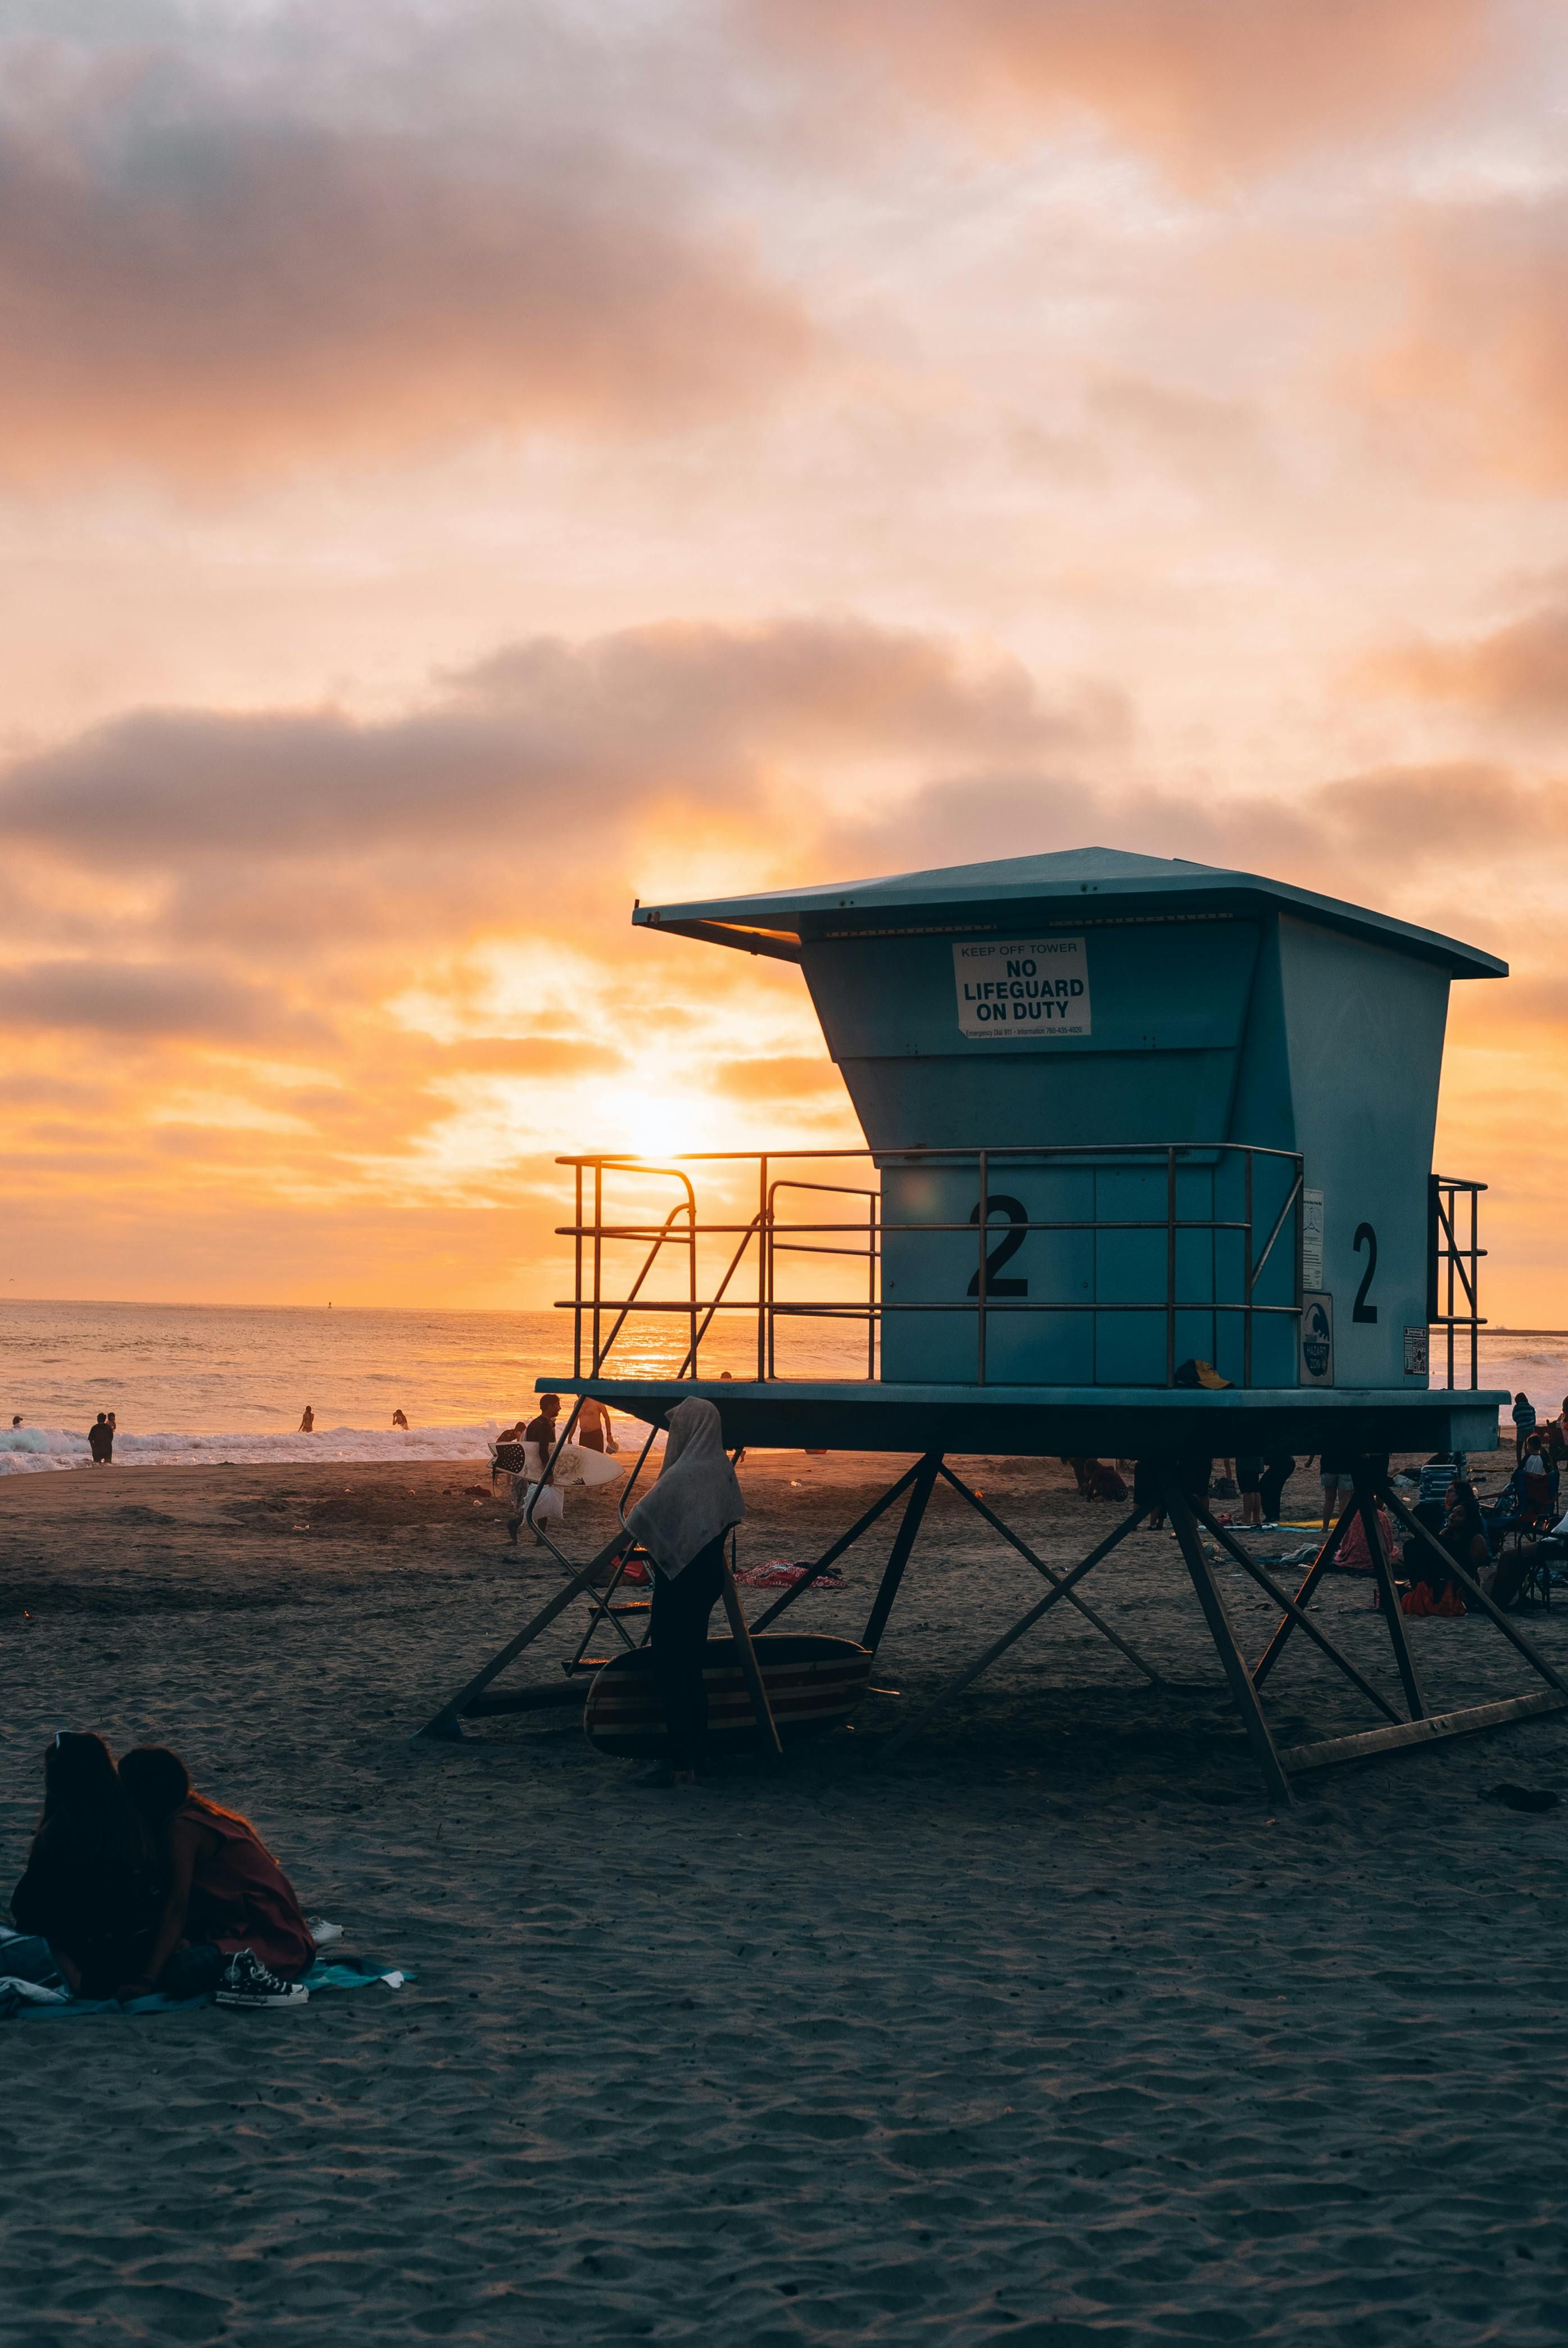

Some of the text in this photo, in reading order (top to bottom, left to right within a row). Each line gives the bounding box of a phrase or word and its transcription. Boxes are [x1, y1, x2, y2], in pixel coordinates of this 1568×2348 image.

[962, 943, 1077, 957] KEEP OFF TOWER
[1007, 959, 1037, 978] NO
[964, 979, 1084, 1001] LIFEGUARD
[976, 1001, 1069, 1021] ON DUTY
[967, 1195, 1028, 1296] 2
[1353, 1222, 1377, 1323] 2
[1307, 1345, 1327, 1355] HAZARD
